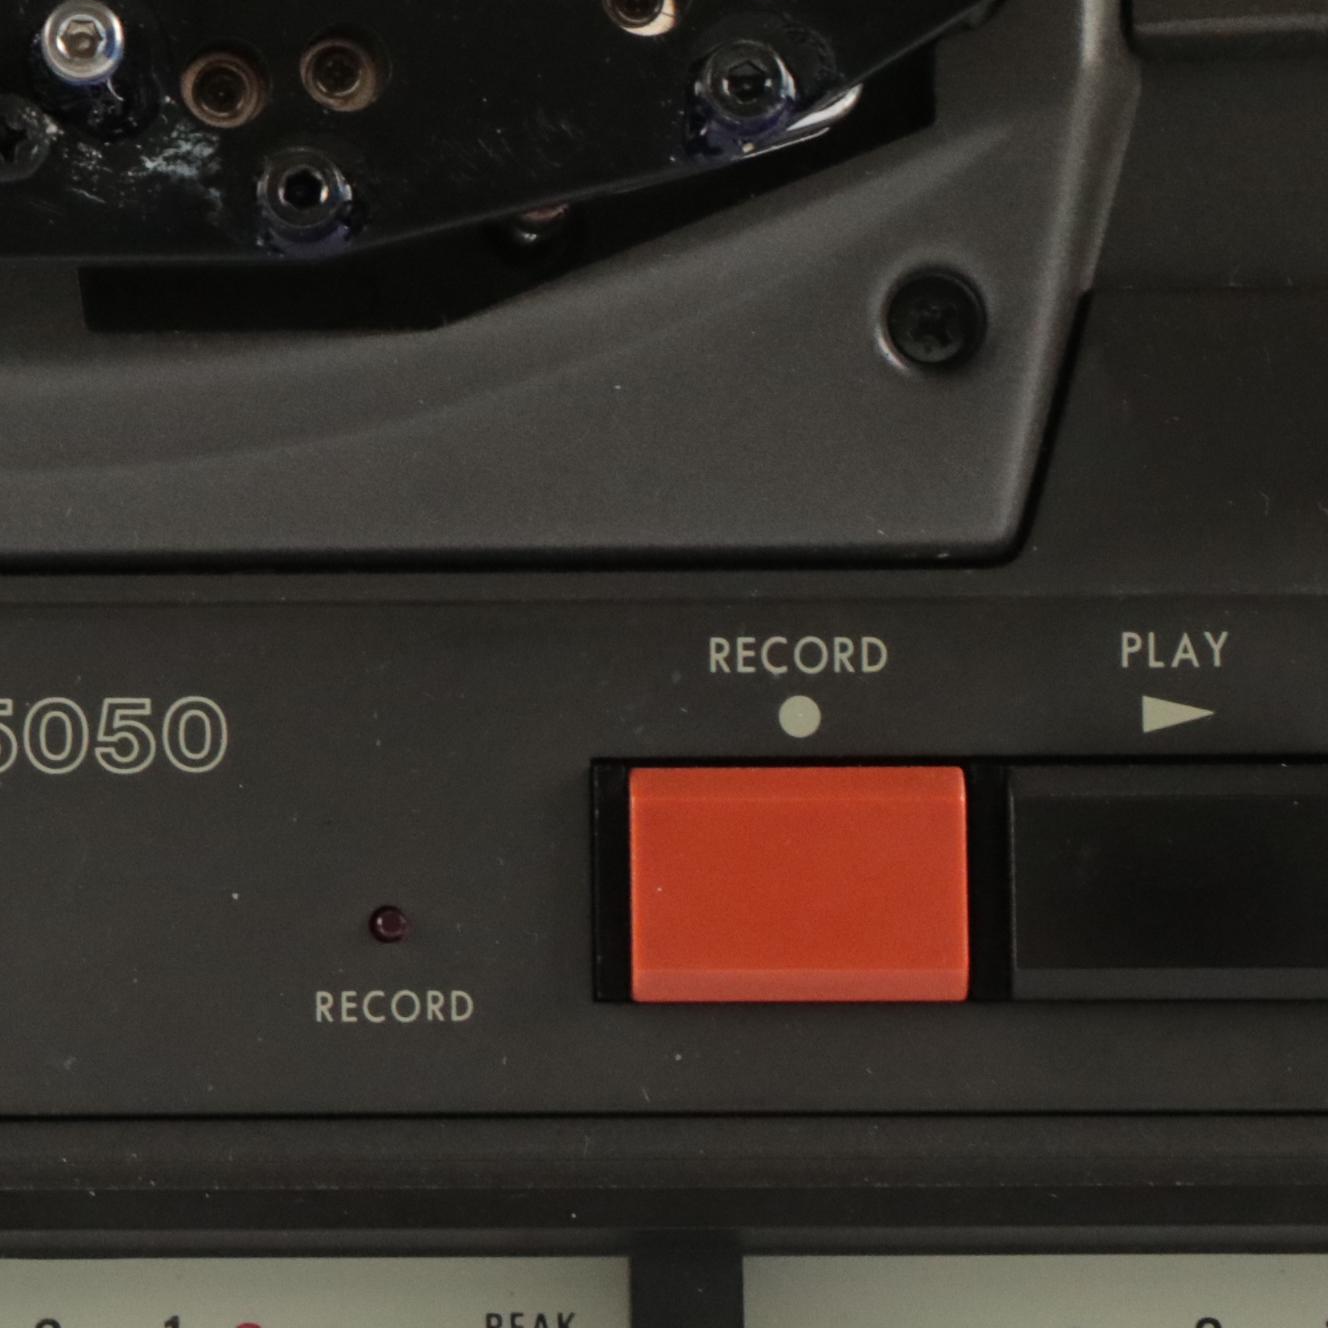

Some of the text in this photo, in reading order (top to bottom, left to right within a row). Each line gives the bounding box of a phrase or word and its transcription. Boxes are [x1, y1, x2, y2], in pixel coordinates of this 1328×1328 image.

[709, 635, 888, 674] RECORD
[1121, 631, 1228, 669] PLAY
[315, 989, 474, 1024] RECORD
